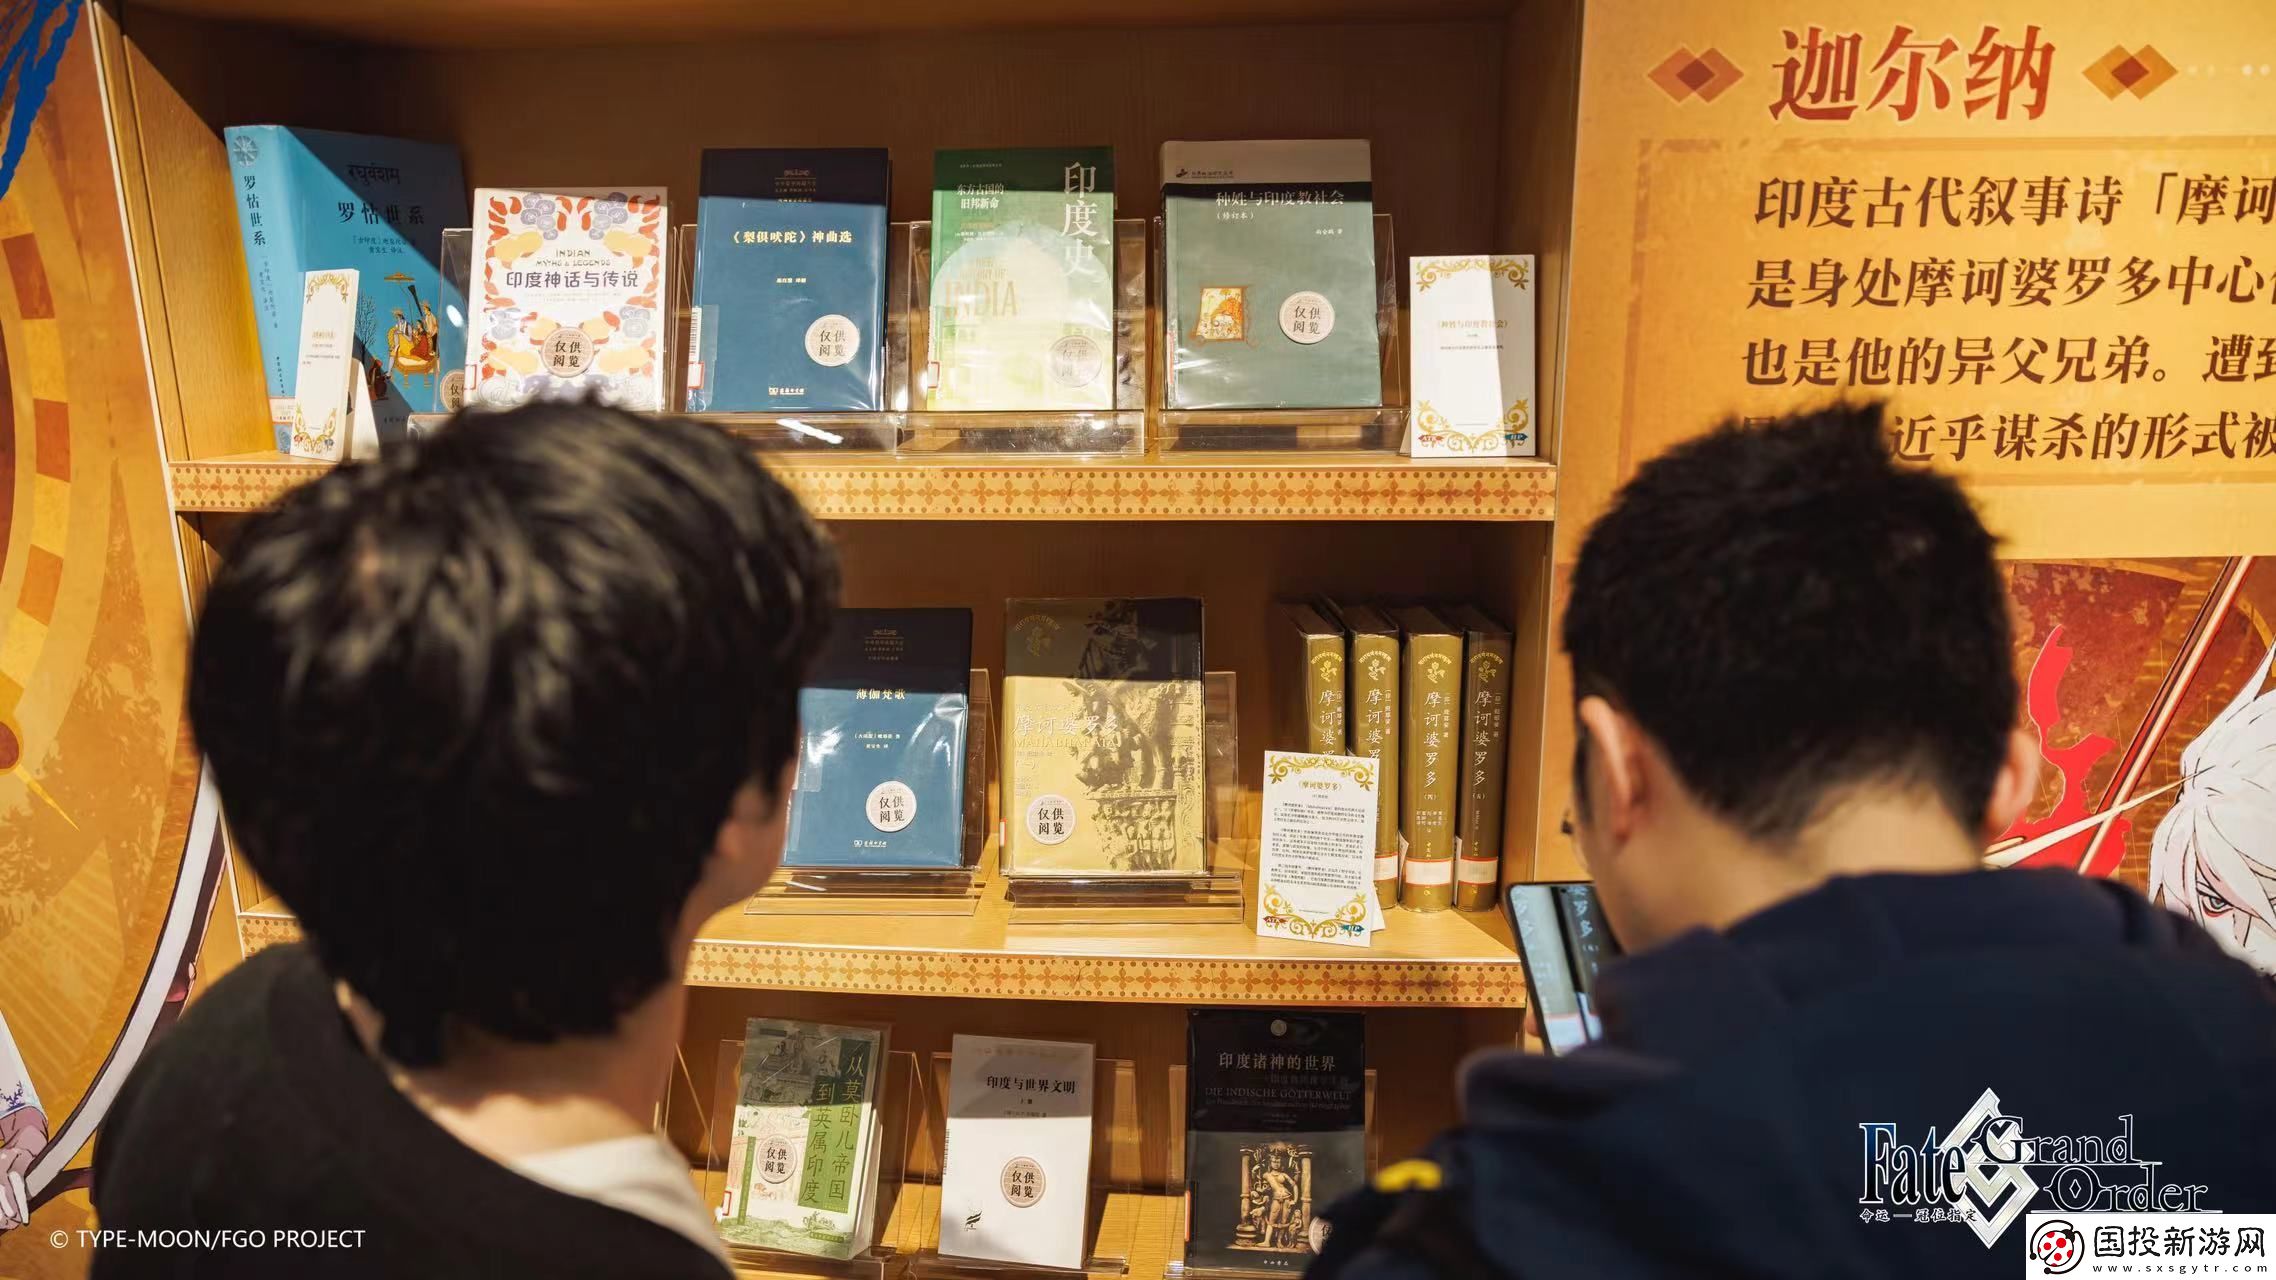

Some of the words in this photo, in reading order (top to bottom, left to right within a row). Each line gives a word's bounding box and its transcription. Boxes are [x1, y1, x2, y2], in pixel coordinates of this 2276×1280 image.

[1768, 24, 2056, 122] 迦尔纳
[957, 183, 1005, 196] 东方古国的
[960, 196, 1000, 210] 旧邦新命
[1215, 189, 1345, 207] 种姓与印度教社会
[1753, 170, 2276, 230] 印度古代叙事诗「摩诃
[244, 175, 266, 246] 罗怙世系
[337, 202, 424, 224] 罗怙世系
[1061, 161, 1103, 283] 印度史
[555, 249, 591, 258] INDIAN
[506, 270, 638, 288] 印度神话与传说
[1746, 255, 2276, 310] 是身处摩诃婆罗多中心
[1294, 305, 1321, 320] 仅供
[818, 328, 846, 342] 仅供
[1293, 320, 1321, 335] 阅览
[555, 340, 582, 353] 仅供
[818, 344, 846, 357] 阅览
[553, 354, 580, 367] 阅览
[1012, 713, 1120, 737] 摩诃婆罗多
[1423, 691, 1443, 788] 摩诃婆罗多
[1472, 690, 1493, 787] 摩诃婆罗多
[879, 795, 904, 808] 仅供
[879, 809, 905, 823] 阅览
[1038, 807, 1064, 821] 仅供
[1038, 821, 1065, 835] 阅览
[1219, 1051, 1336, 1072] 印度诸神的世界
[986, 1075, 1076, 1094] 印度与世界文明
[829, 1055, 864, 1201] 从莫卧儿帝国
[800, 1081, 835, 1204] 到英属印度
[767, 1146, 788, 1160] 仅供
[764, 1160, 786, 1175] 阅览
[1012, 1170, 1035, 1184] 仅供
[1011, 1184, 1035, 1199] 阅览
